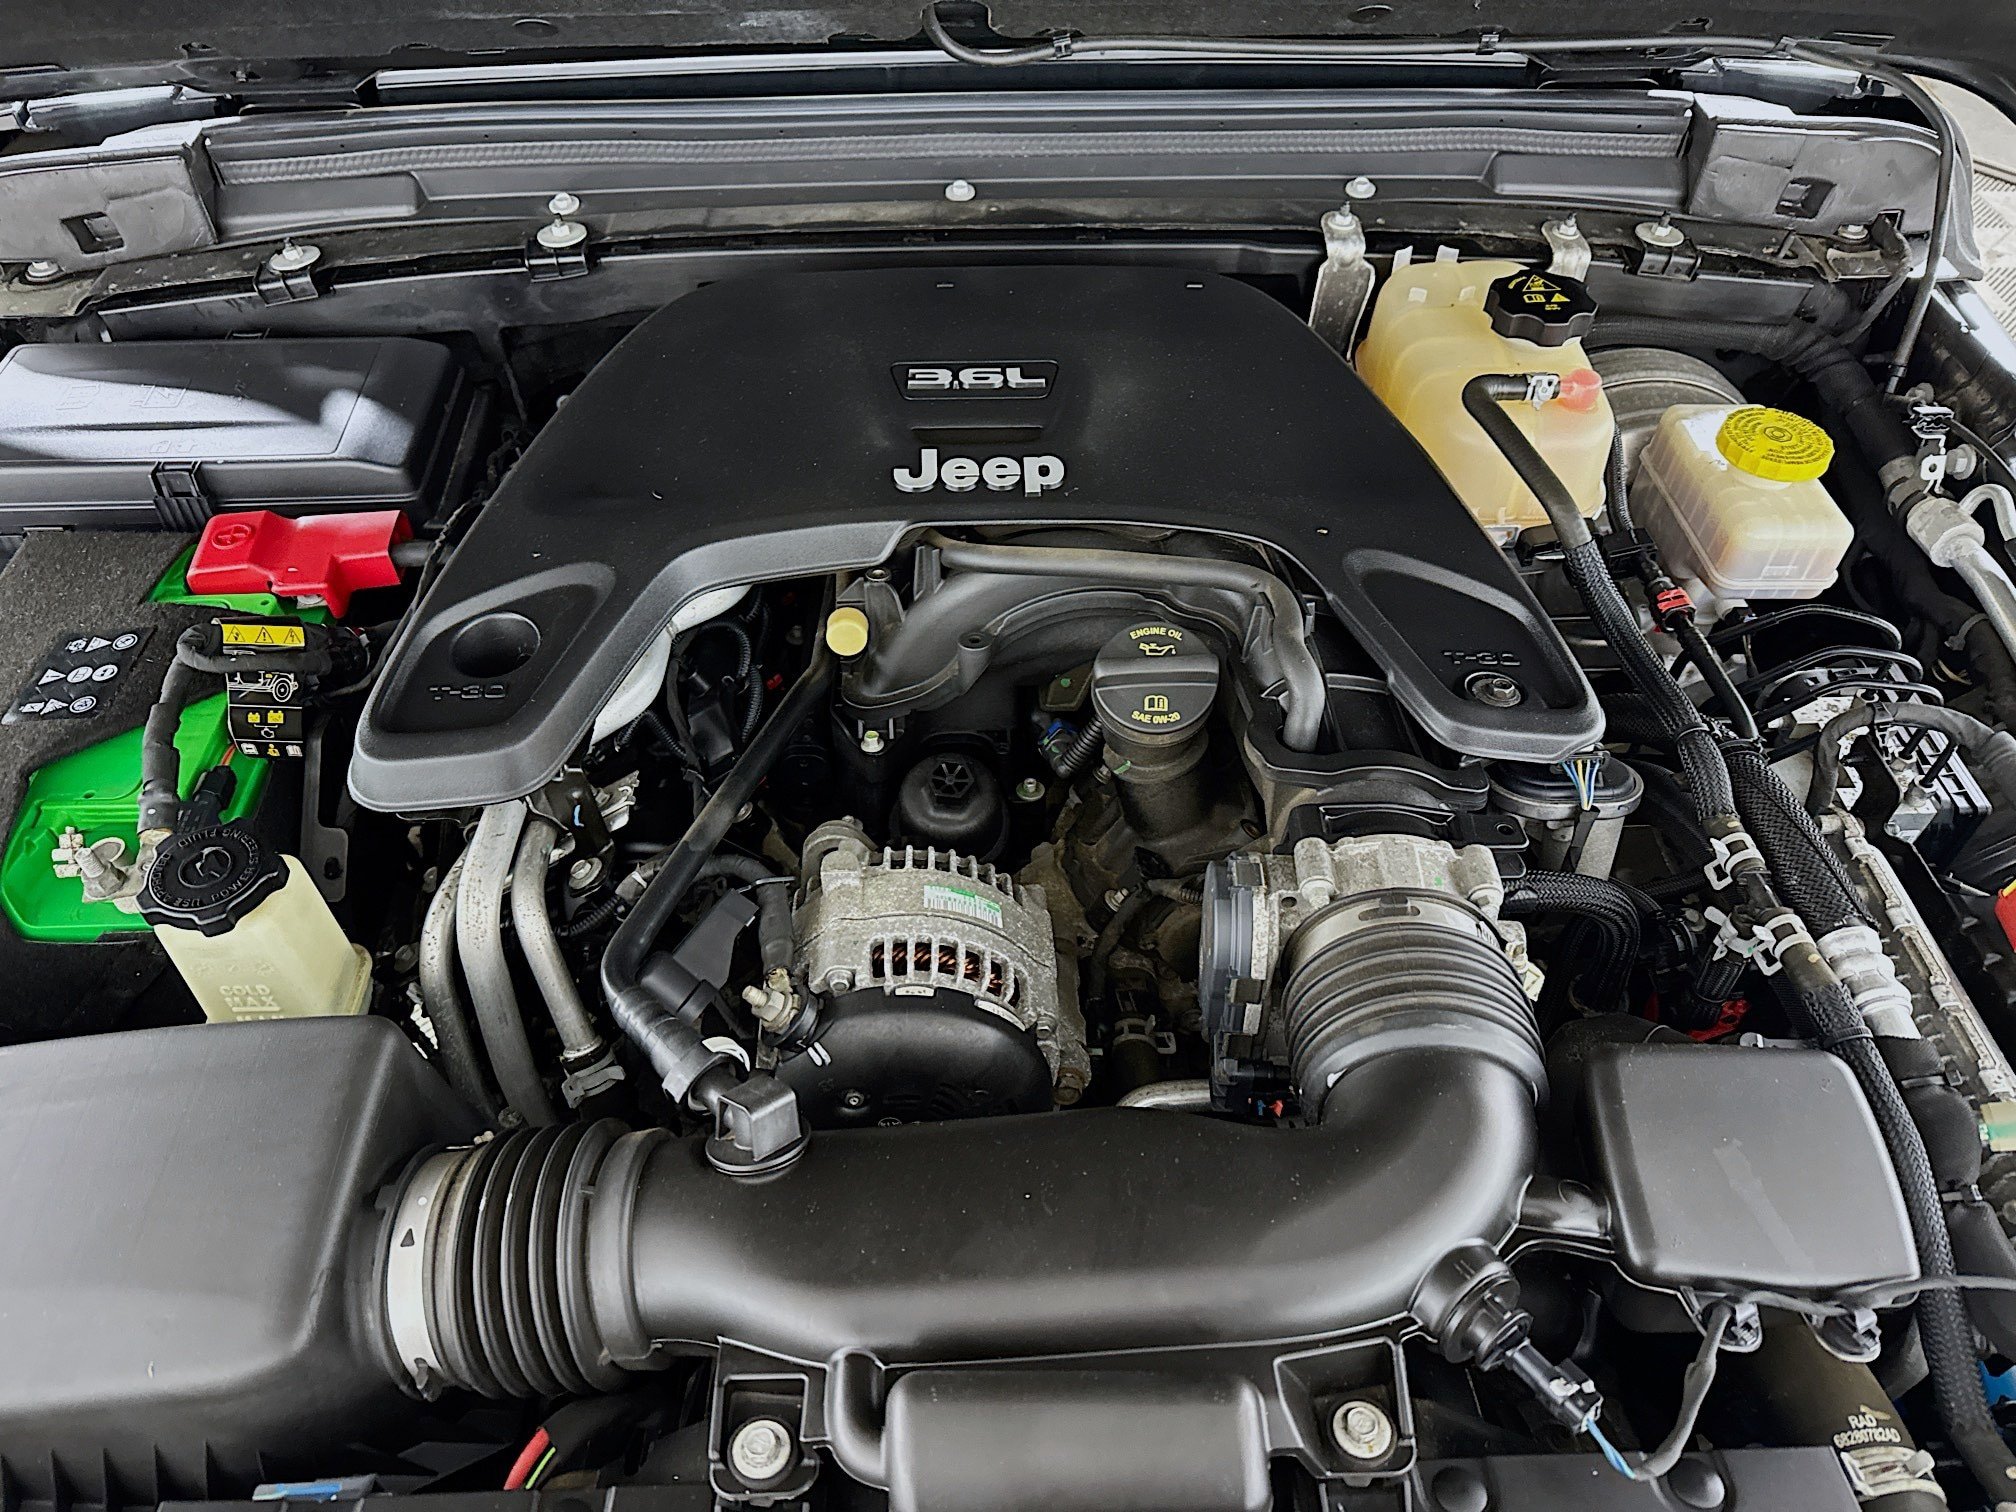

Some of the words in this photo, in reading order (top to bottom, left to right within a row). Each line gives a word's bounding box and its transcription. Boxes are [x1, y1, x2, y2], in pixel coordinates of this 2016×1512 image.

[907, 367, 1046, 390] 3.6L
[893, 448, 1065, 497] Jeep
[1129, 626, 1167, 640] ENGINE
[1167, 629, 1184, 641] OIL
[1131, 710, 1152, 724] SAE
[1152, 711, 1181, 725] 0W-20
[177, 828, 218, 848] FLUID
[222, 828, 260, 865] STEERING
[151, 852, 172, 902] APPROVED
[210, 866, 255, 902] POWER
[173, 896, 201, 908] USE
[219, 983, 271, 996] COLD
[223, 996, 279, 1008] MAX
[1848, 1413, 1877, 1429] RAD
